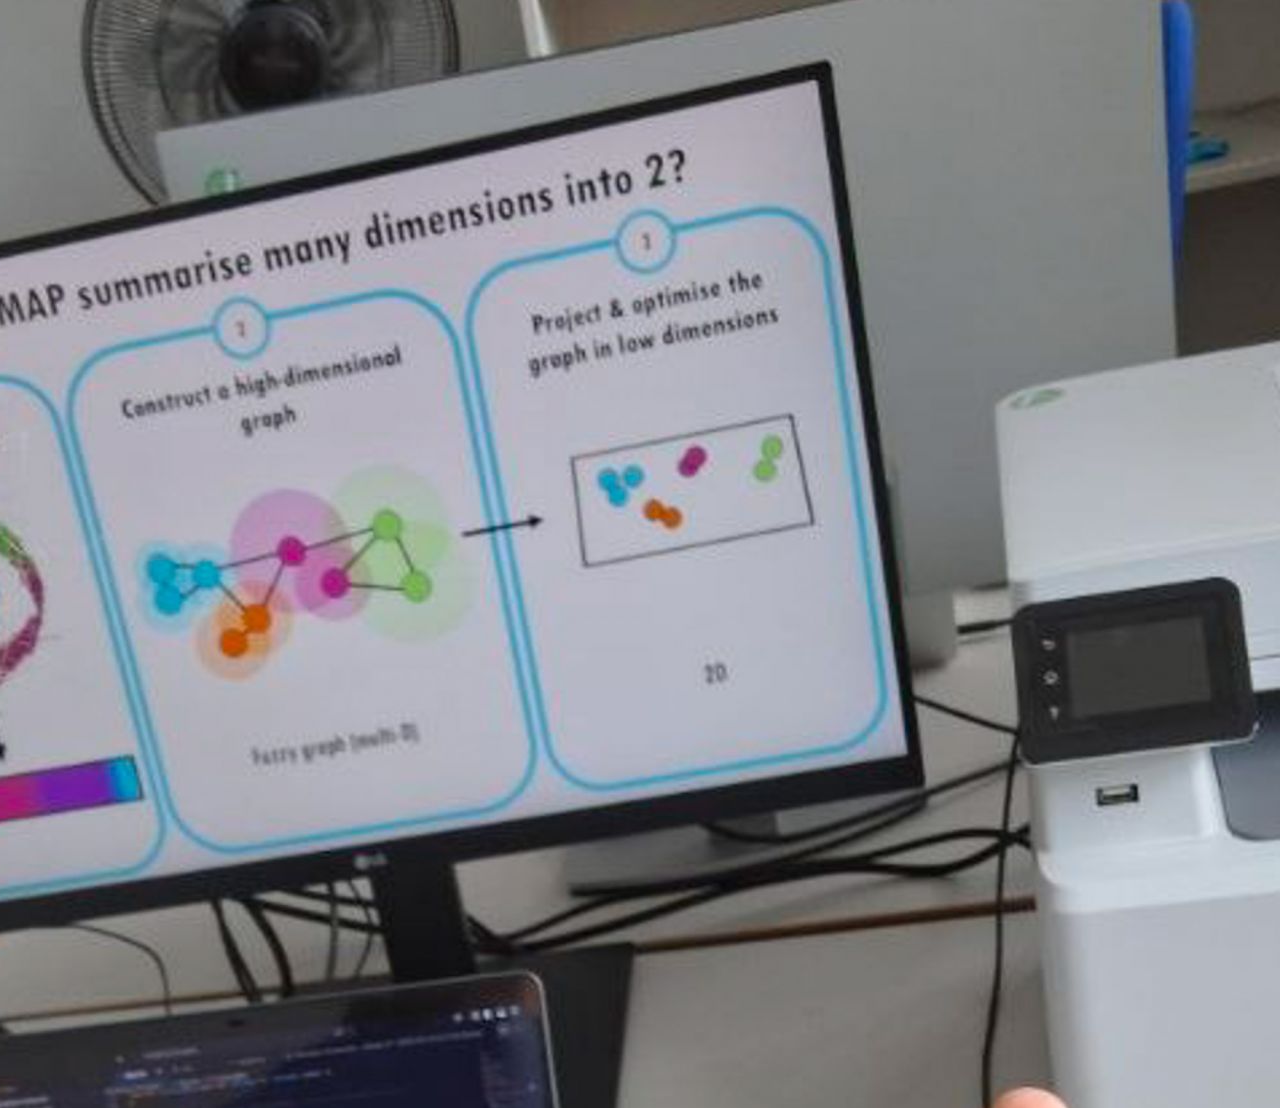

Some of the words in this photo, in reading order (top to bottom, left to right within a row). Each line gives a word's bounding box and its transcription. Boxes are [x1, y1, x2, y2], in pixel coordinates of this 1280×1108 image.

[77, 250, 252, 310] summarise
[263, 229, 351, 265] many
[364, 187, 554, 249] dimensions
[564, 167, 633, 206] into
[644, 149, 686, 190] 2?
[530, 304, 602, 336] Project
[609, 298, 624, 318] &
[632, 279, 721, 320] optimise
[728, 269, 763, 294] the
[528, 343, 587, 379] graph
[593, 340, 612, 360] in
[619, 334, 655, 352] low
[662, 307, 780, 345] dimensions
[121, 386, 211, 419] Construct
[217, 386, 230, 400] a
[234, 345, 402, 398] high-dimensional
[240, 406, 297, 437] graph
